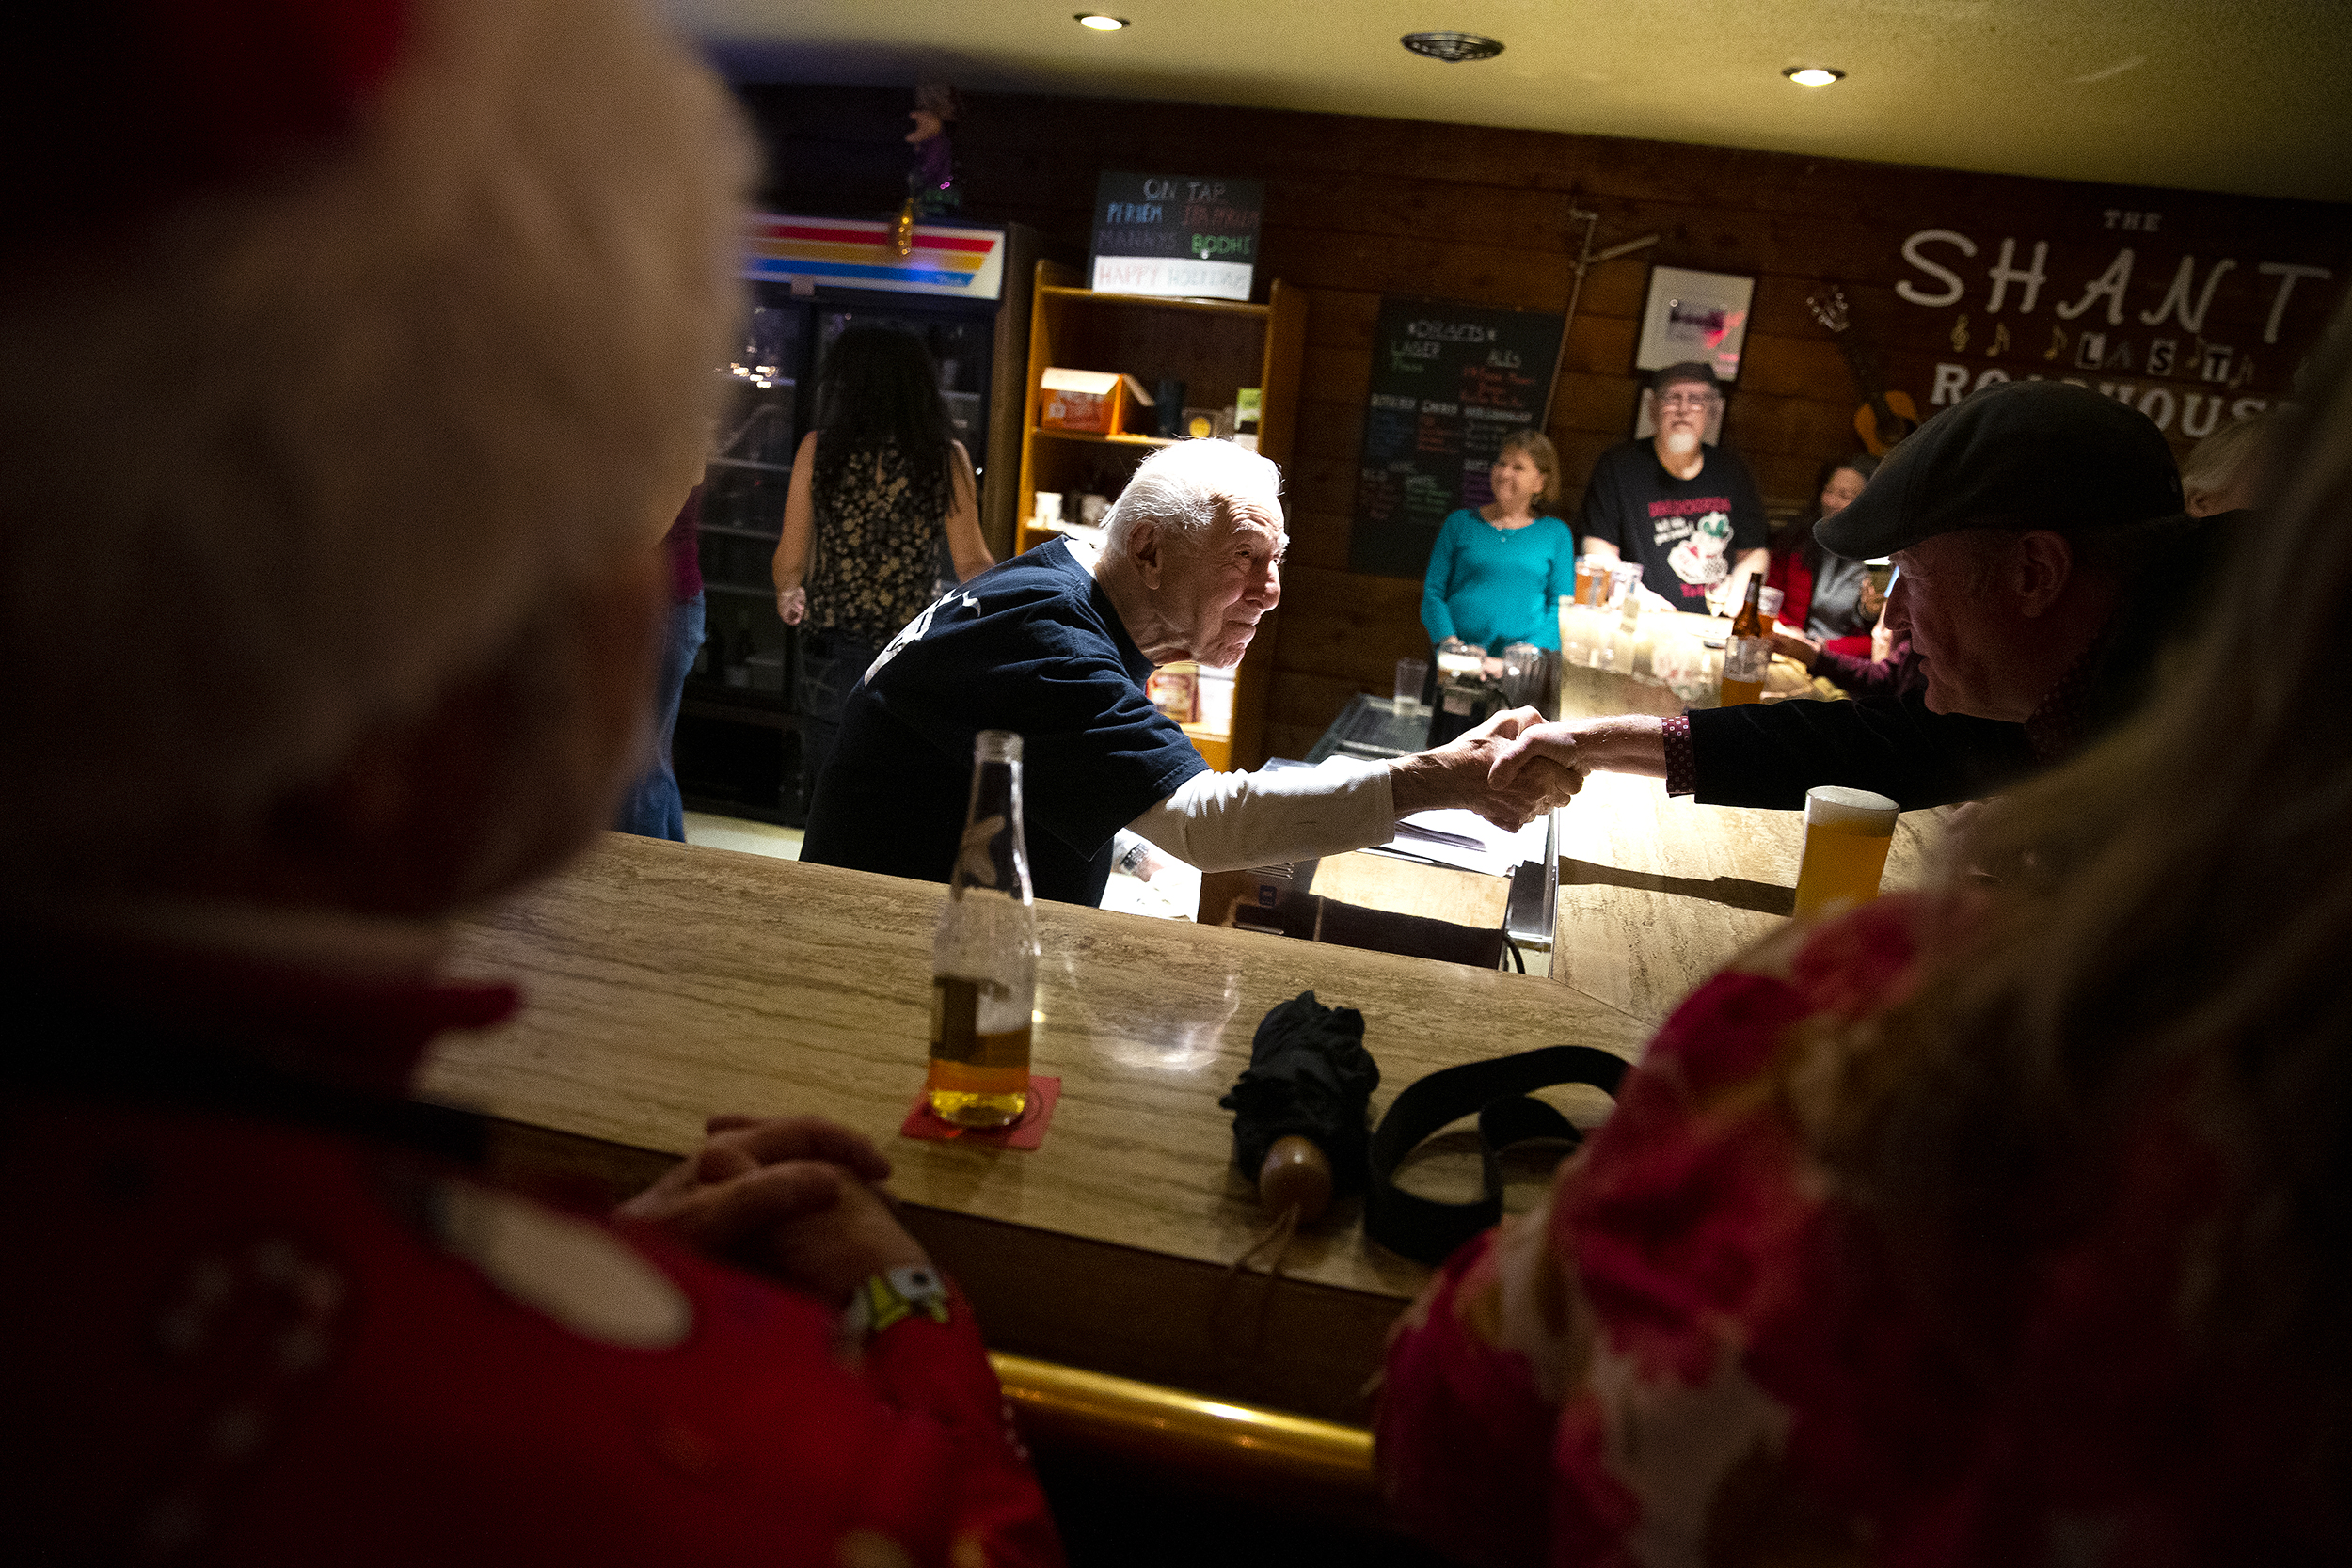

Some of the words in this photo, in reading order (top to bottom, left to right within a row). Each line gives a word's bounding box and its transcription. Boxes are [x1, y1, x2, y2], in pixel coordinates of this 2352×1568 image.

[1143, 178, 1177, 201] ON
[1187, 180, 1226, 202] TAP
[2103, 208, 2163, 234] THE
[1191, 233, 1251, 255] BODHI
[1099, 262, 1160, 287] HAPPY
[1391, 341, 1441, 359] LAGER
[1486, 348, 1522, 368] ALES
